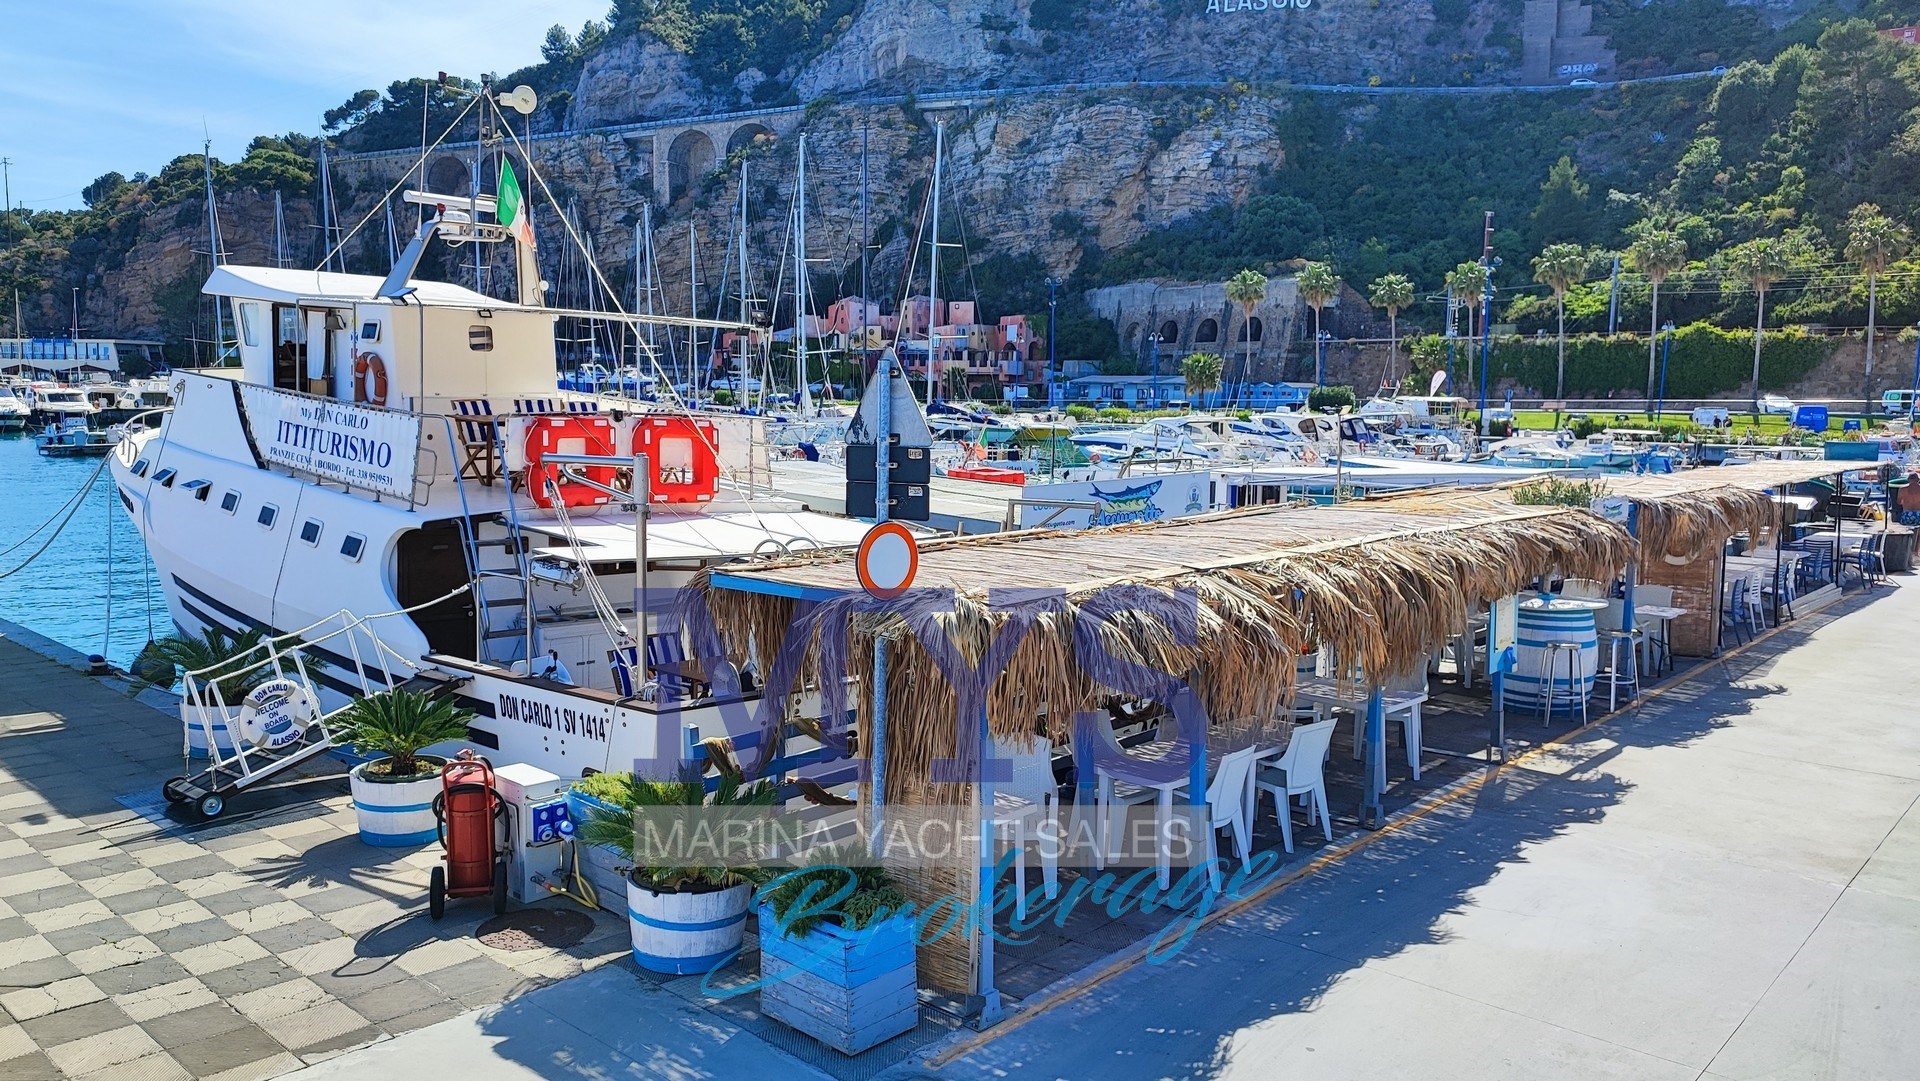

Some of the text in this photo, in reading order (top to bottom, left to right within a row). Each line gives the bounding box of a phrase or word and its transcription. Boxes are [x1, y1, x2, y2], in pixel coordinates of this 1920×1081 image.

[314, 407, 334, 424] DN
[335, 411, 369, 430] CARLO
[276, 419, 392, 468] ITTITURISMO
[318, 460, 341, 473] BORDO
[254, 684, 288, 702] DON CARLO
[255, 696, 290, 717] WELCOME
[268, 710, 279, 719] ON
[264, 714, 289, 730] BOARD
[499, 693, 606, 743] DON CARLO 1 SV 1414
[271, 729, 300, 747] ALASSIO
